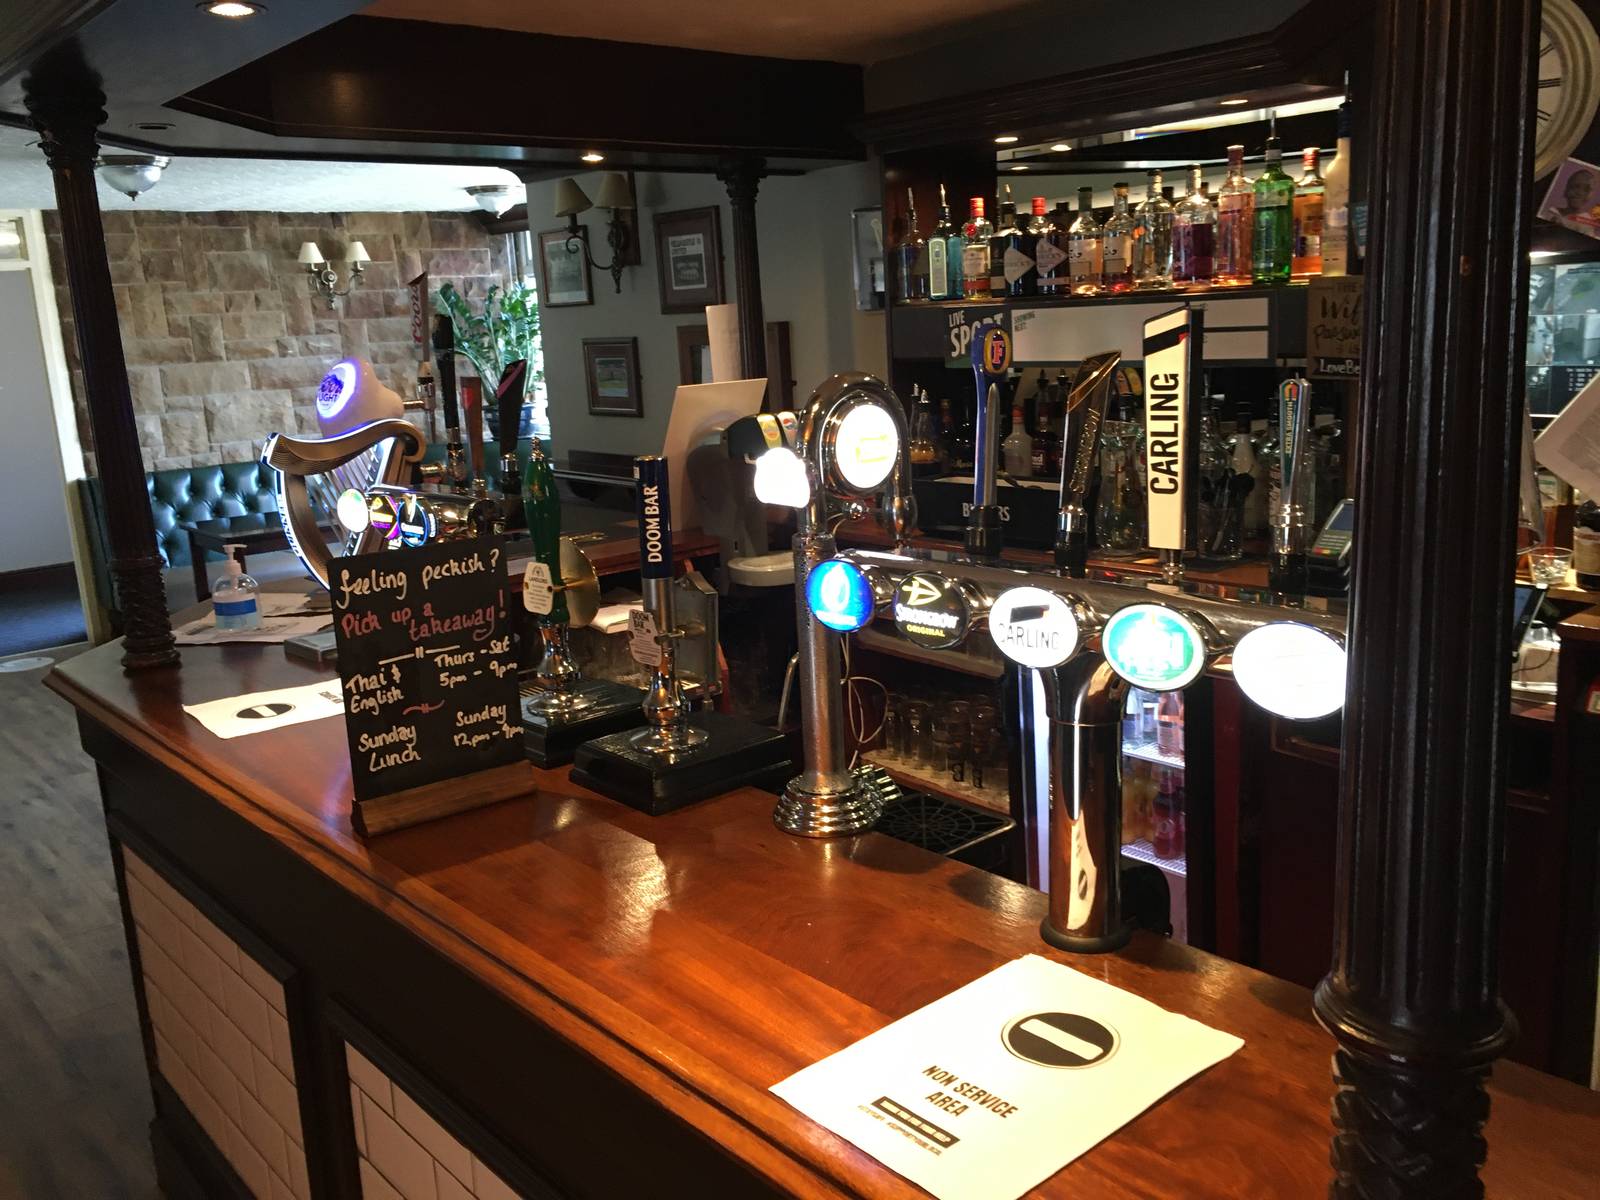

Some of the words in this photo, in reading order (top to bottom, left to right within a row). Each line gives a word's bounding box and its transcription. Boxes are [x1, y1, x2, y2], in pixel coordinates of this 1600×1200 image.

[948, 310, 965, 327] LIVE
[950, 313, 1003, 357] SPT
[992, 340, 1004, 364] F
[1150, 373, 1179, 495] CARLING
[643, 484, 660, 515] BAR
[645, 518, 663, 562] DOOM
[336, 569, 407, 610] feeling
[341, 610, 382, 639] Pick
[391, 607, 412, 626] up
[423, 602, 434, 617] a
[434, 651, 475, 668] Thurs
[488, 635, 510, 654] Sat
[345, 667, 387, 694] Thai
[439, 672, 467, 688] 5pm
[489, 660, 518, 678] 9pm
[350, 686, 405, 716] English
[455, 703, 507, 728] Sunday
[358, 724, 417, 752] Sunday
[369, 744, 422, 773] Lunch
[921, 1065, 958, 1087] NON
[953, 1082, 1019, 1119] SERVICE
[925, 1091, 970, 1117] AREA
